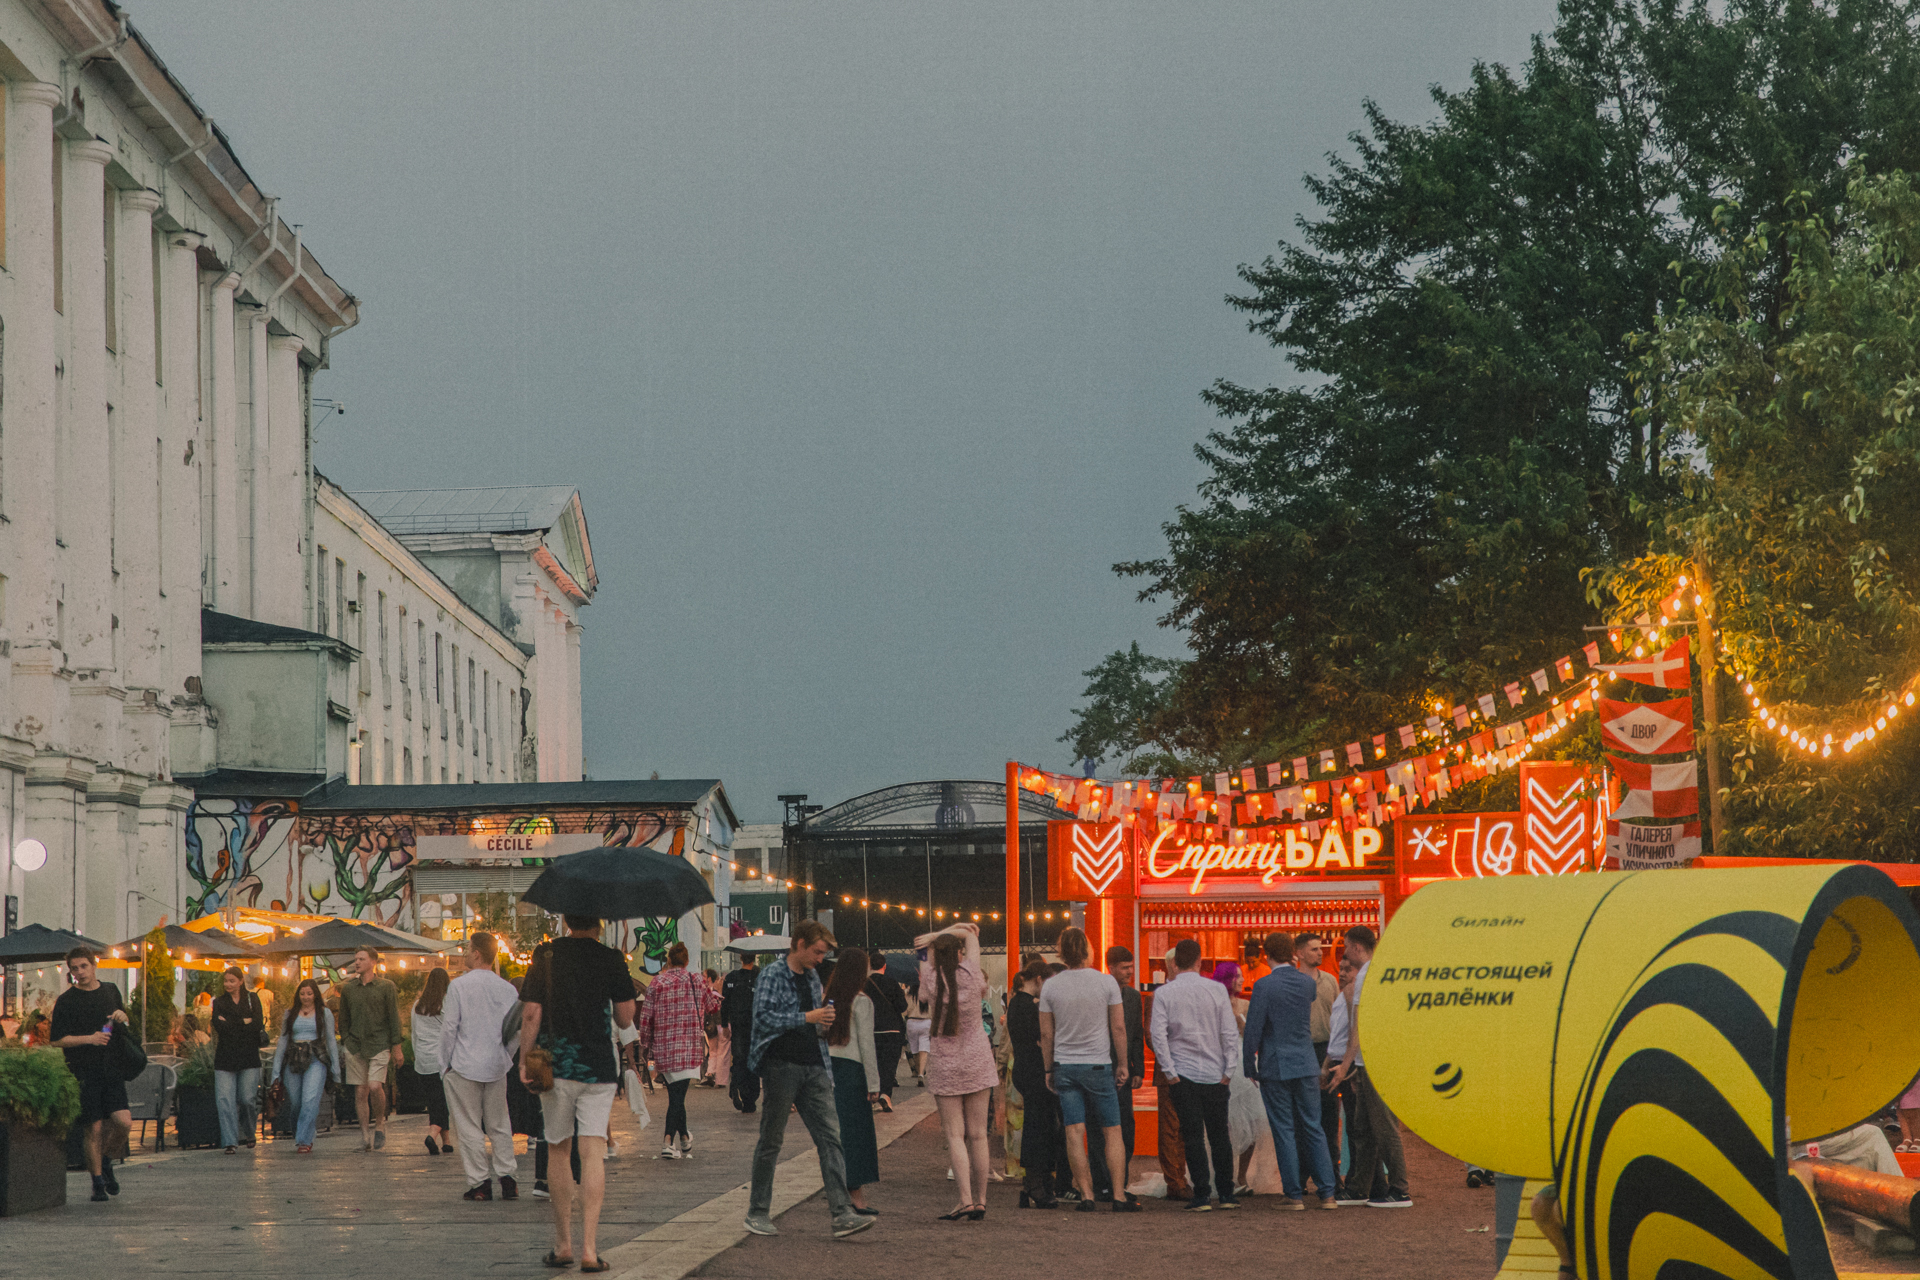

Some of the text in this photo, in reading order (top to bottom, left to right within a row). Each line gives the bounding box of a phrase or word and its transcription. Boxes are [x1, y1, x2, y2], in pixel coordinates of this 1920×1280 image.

[1631, 724, 1657, 739] ДВОР
[1630, 826, 1672, 843] ГАЛЕРЕЯ
[1626, 842, 1675, 860] УЛИЧНОГО
[1451, 916, 1525, 928] билайн
[1380, 962, 1553, 985] для настоящей
[1407, 988, 1514, 1011] удалёнки
